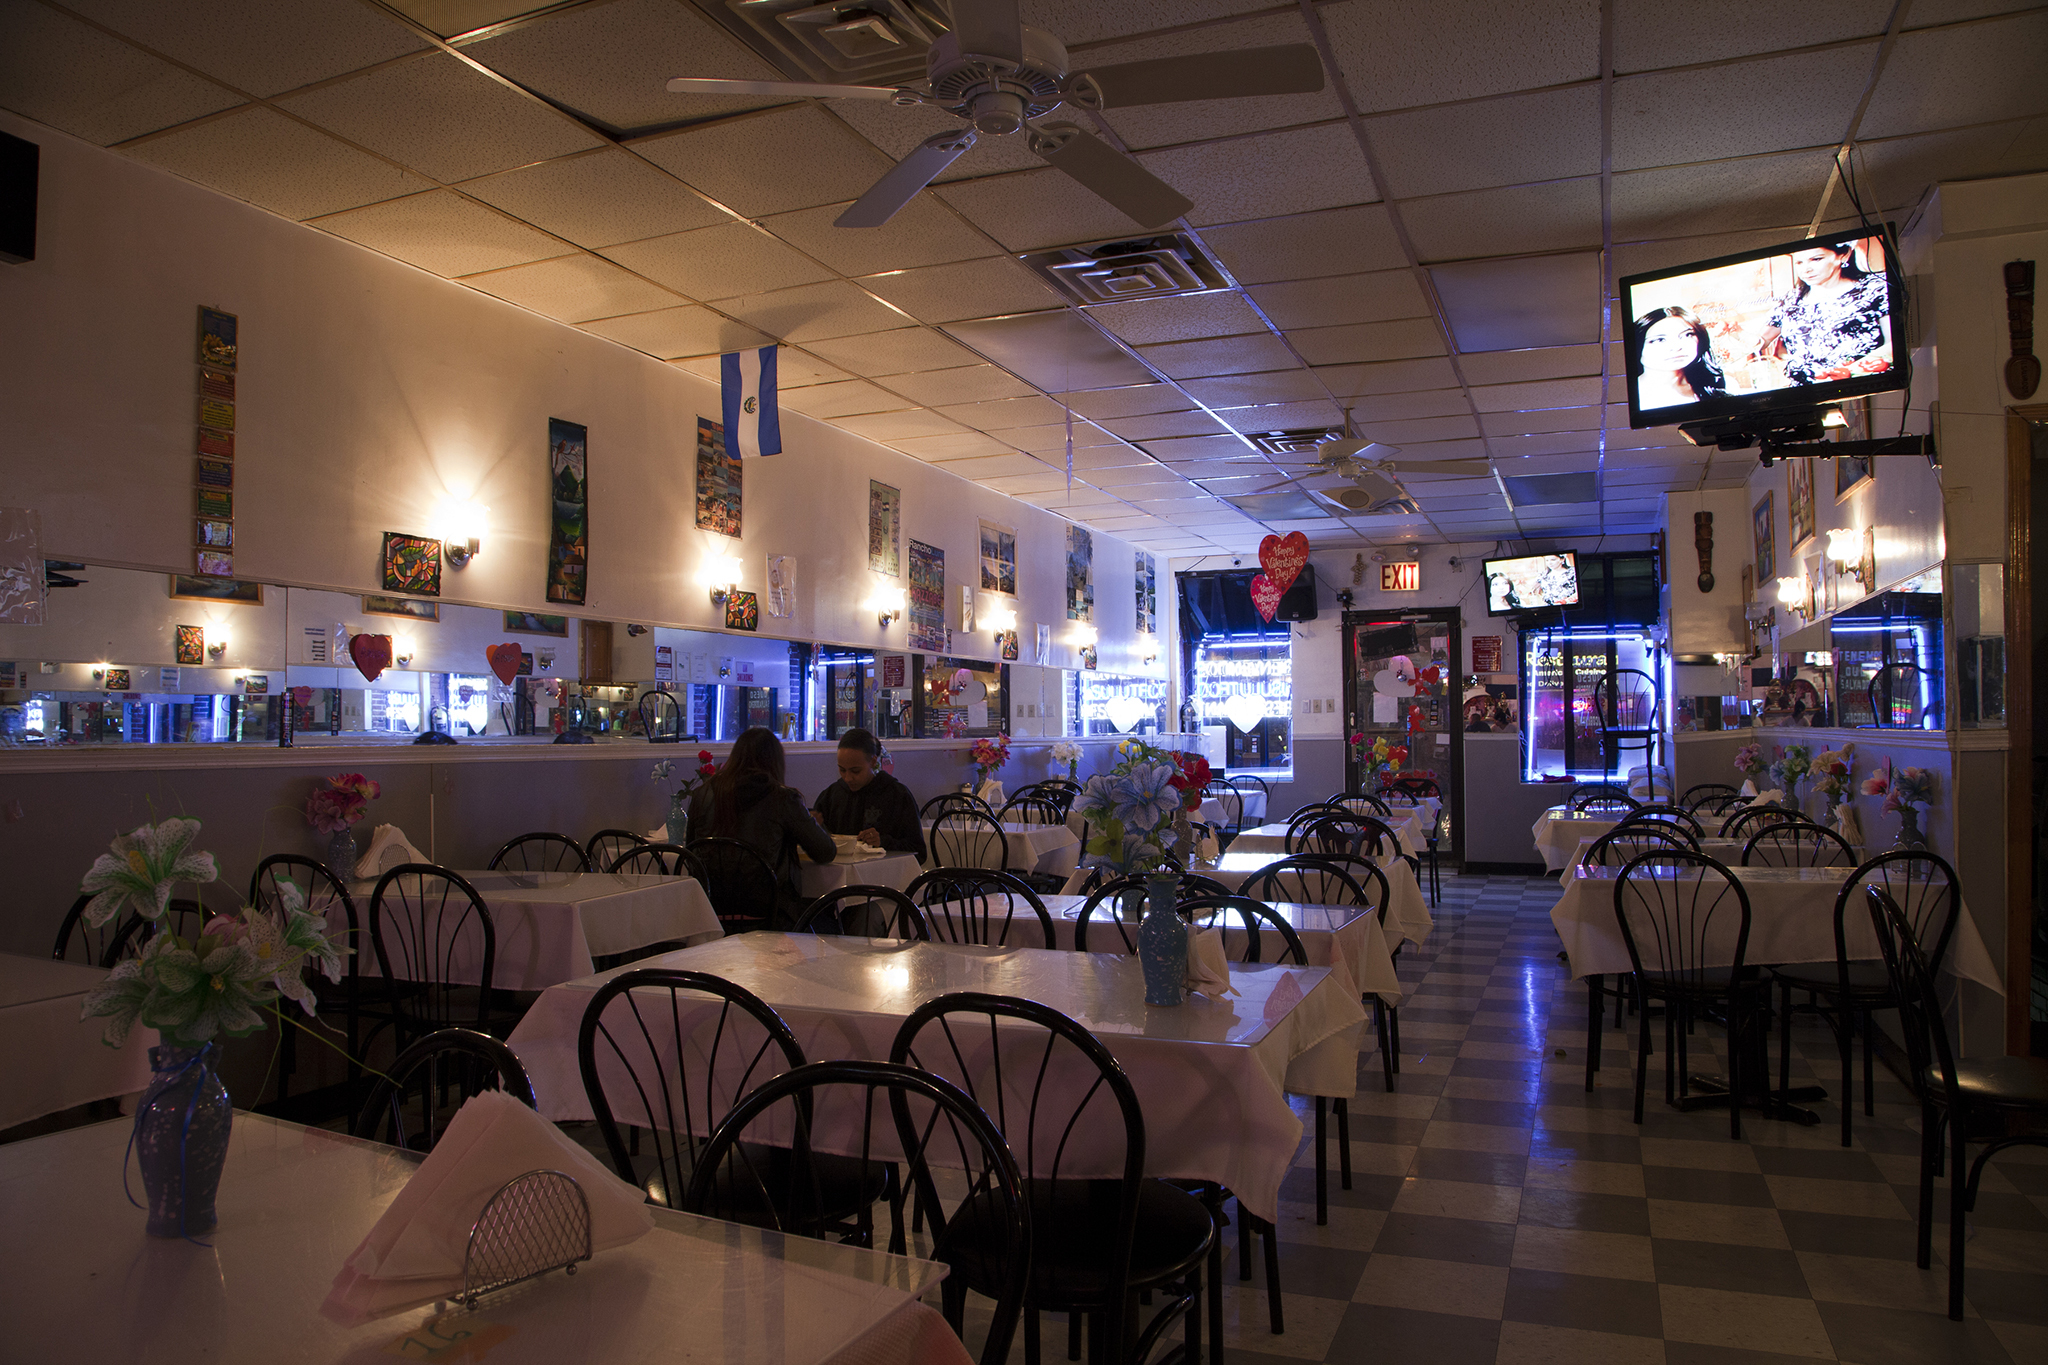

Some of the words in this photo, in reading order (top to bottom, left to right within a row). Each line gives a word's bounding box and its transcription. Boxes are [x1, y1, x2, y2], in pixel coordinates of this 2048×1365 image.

[1272, 544, 1295, 557] Happy
[1265, 554, 1304, 569] Valentine's
[1381, 565, 1417, 590] EXIT
